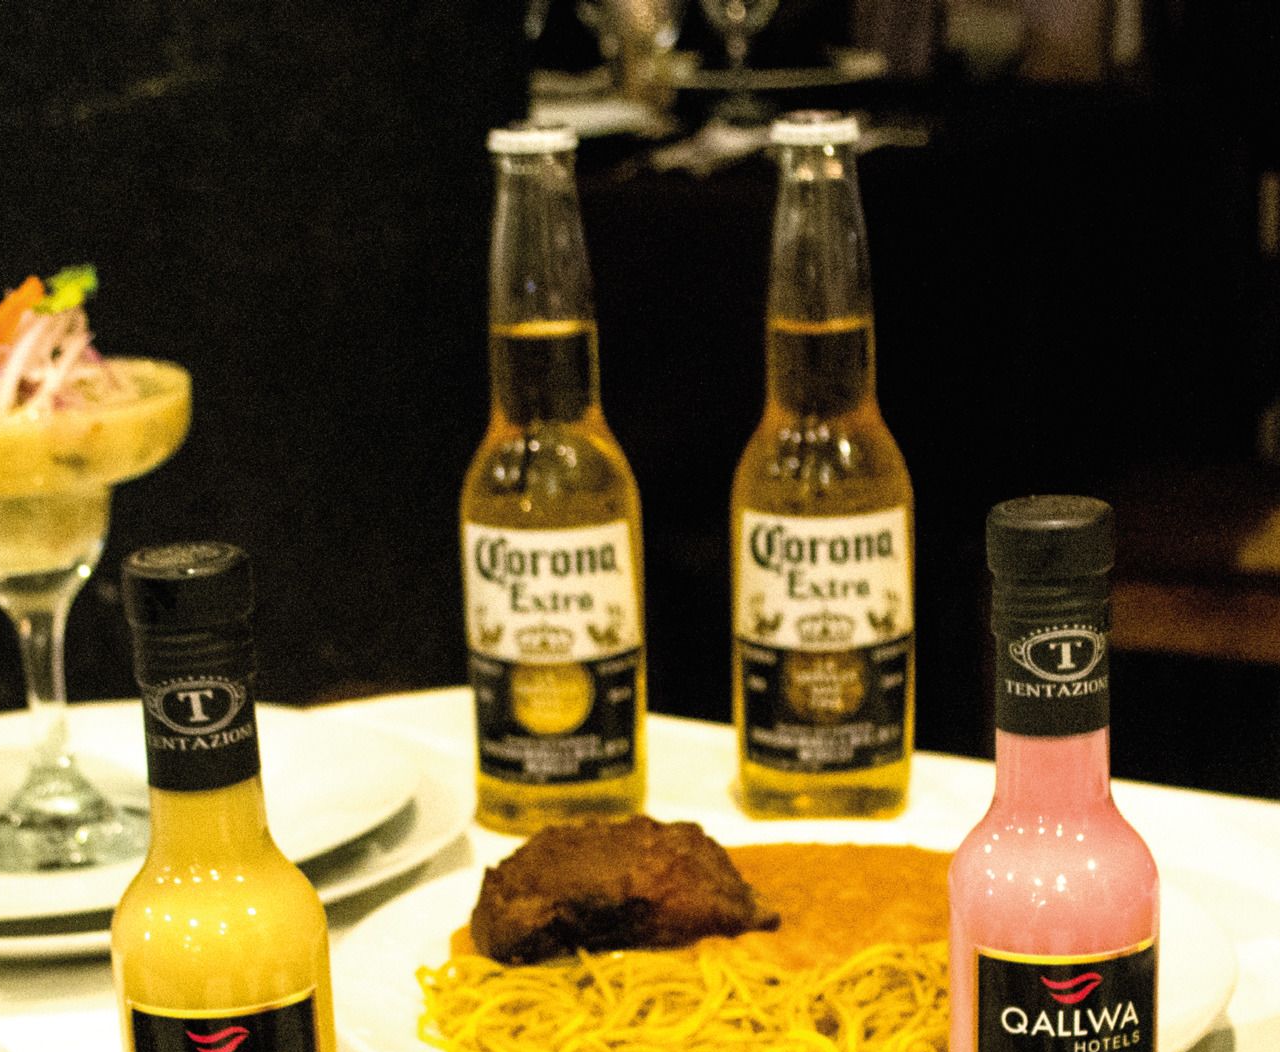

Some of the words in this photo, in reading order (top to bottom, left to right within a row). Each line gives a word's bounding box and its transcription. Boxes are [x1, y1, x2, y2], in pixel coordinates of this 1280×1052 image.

[474, 535, 620, 582] Corona
[749, 522, 894, 576] Corona
[509, 582, 595, 615] Extra
[786, 569, 871, 600] Extra
[1048, 641, 1084, 671] T
[176, 689, 214, 723] T
[1000, 1000, 1140, 1038] QALLWA
